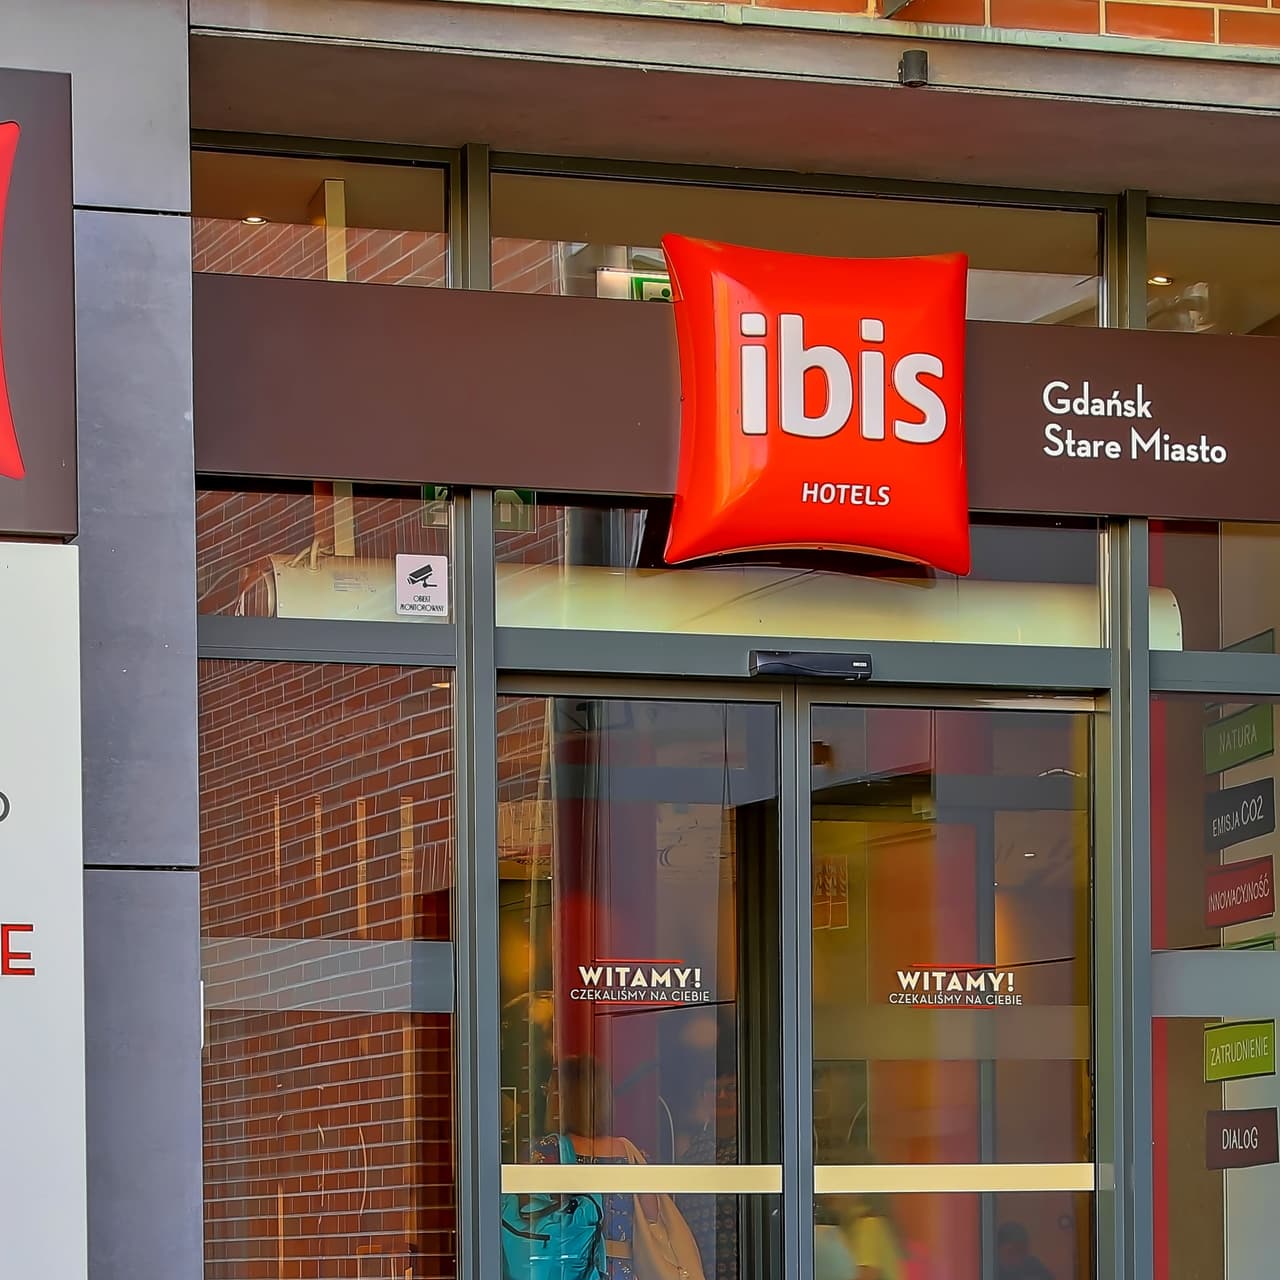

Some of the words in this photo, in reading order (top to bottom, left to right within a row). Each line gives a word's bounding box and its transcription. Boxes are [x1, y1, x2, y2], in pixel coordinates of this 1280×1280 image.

[739, 312, 948, 444] ibis
[1043, 380, 1153, 420] Gdańsk
[1043, 424, 1122, 460] Stare
[1130, 426, 1228, 464] Miasto
[801, 481, 891, 507] HOTELS
[1219, 723, 1258, 753] NATURA
[1212, 812, 1240, 838] EMISJA
[1241, 795, 1264, 826] CO2
[578, 966, 701, 989] WITAMY!
[897, 971, 1015, 992] WITAMY!
[570, 986, 647, 1001] CZEKALIŚMY
[650, 990, 668, 1001] NA
[671, 990, 710, 1002] CIEBIE
[888, 991, 962, 1005] CZEKALIŚMY
[965, 995, 982, 1005] NA
[985, 994, 1023, 1005] CIEBIE
[1210, 1036, 1269, 1067] ZATRUDNIENIE
[1222, 1126, 1259, 1150] DIALOG
